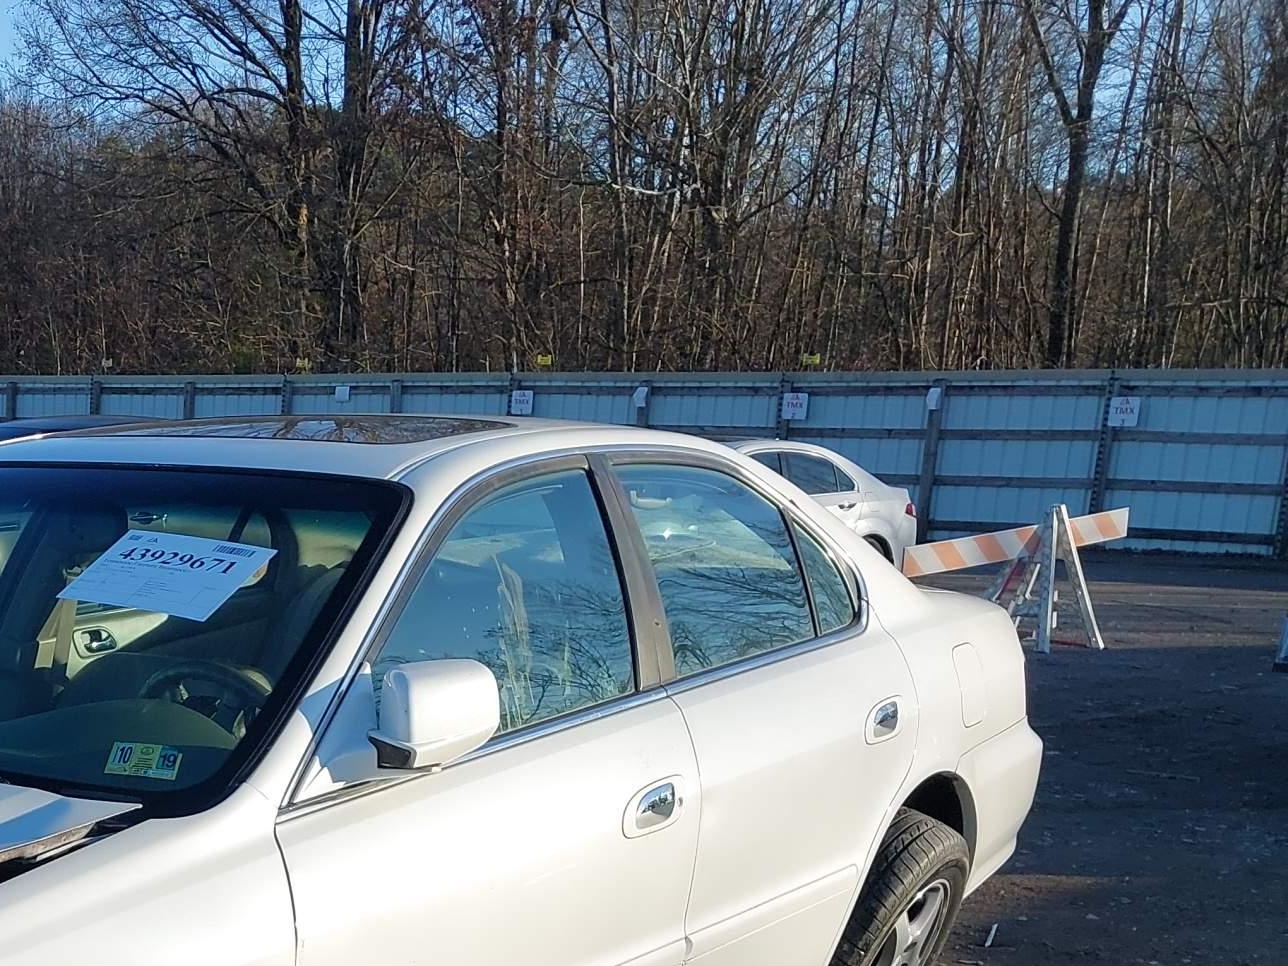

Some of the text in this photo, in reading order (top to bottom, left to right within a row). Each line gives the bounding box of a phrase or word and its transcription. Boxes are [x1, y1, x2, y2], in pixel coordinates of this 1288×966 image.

[1113, 406, 1135, 415] TMX
[119, 545, 239, 576] 43929671
[118, 746, 133, 764] 10
[161, 753, 177, 769] 19
